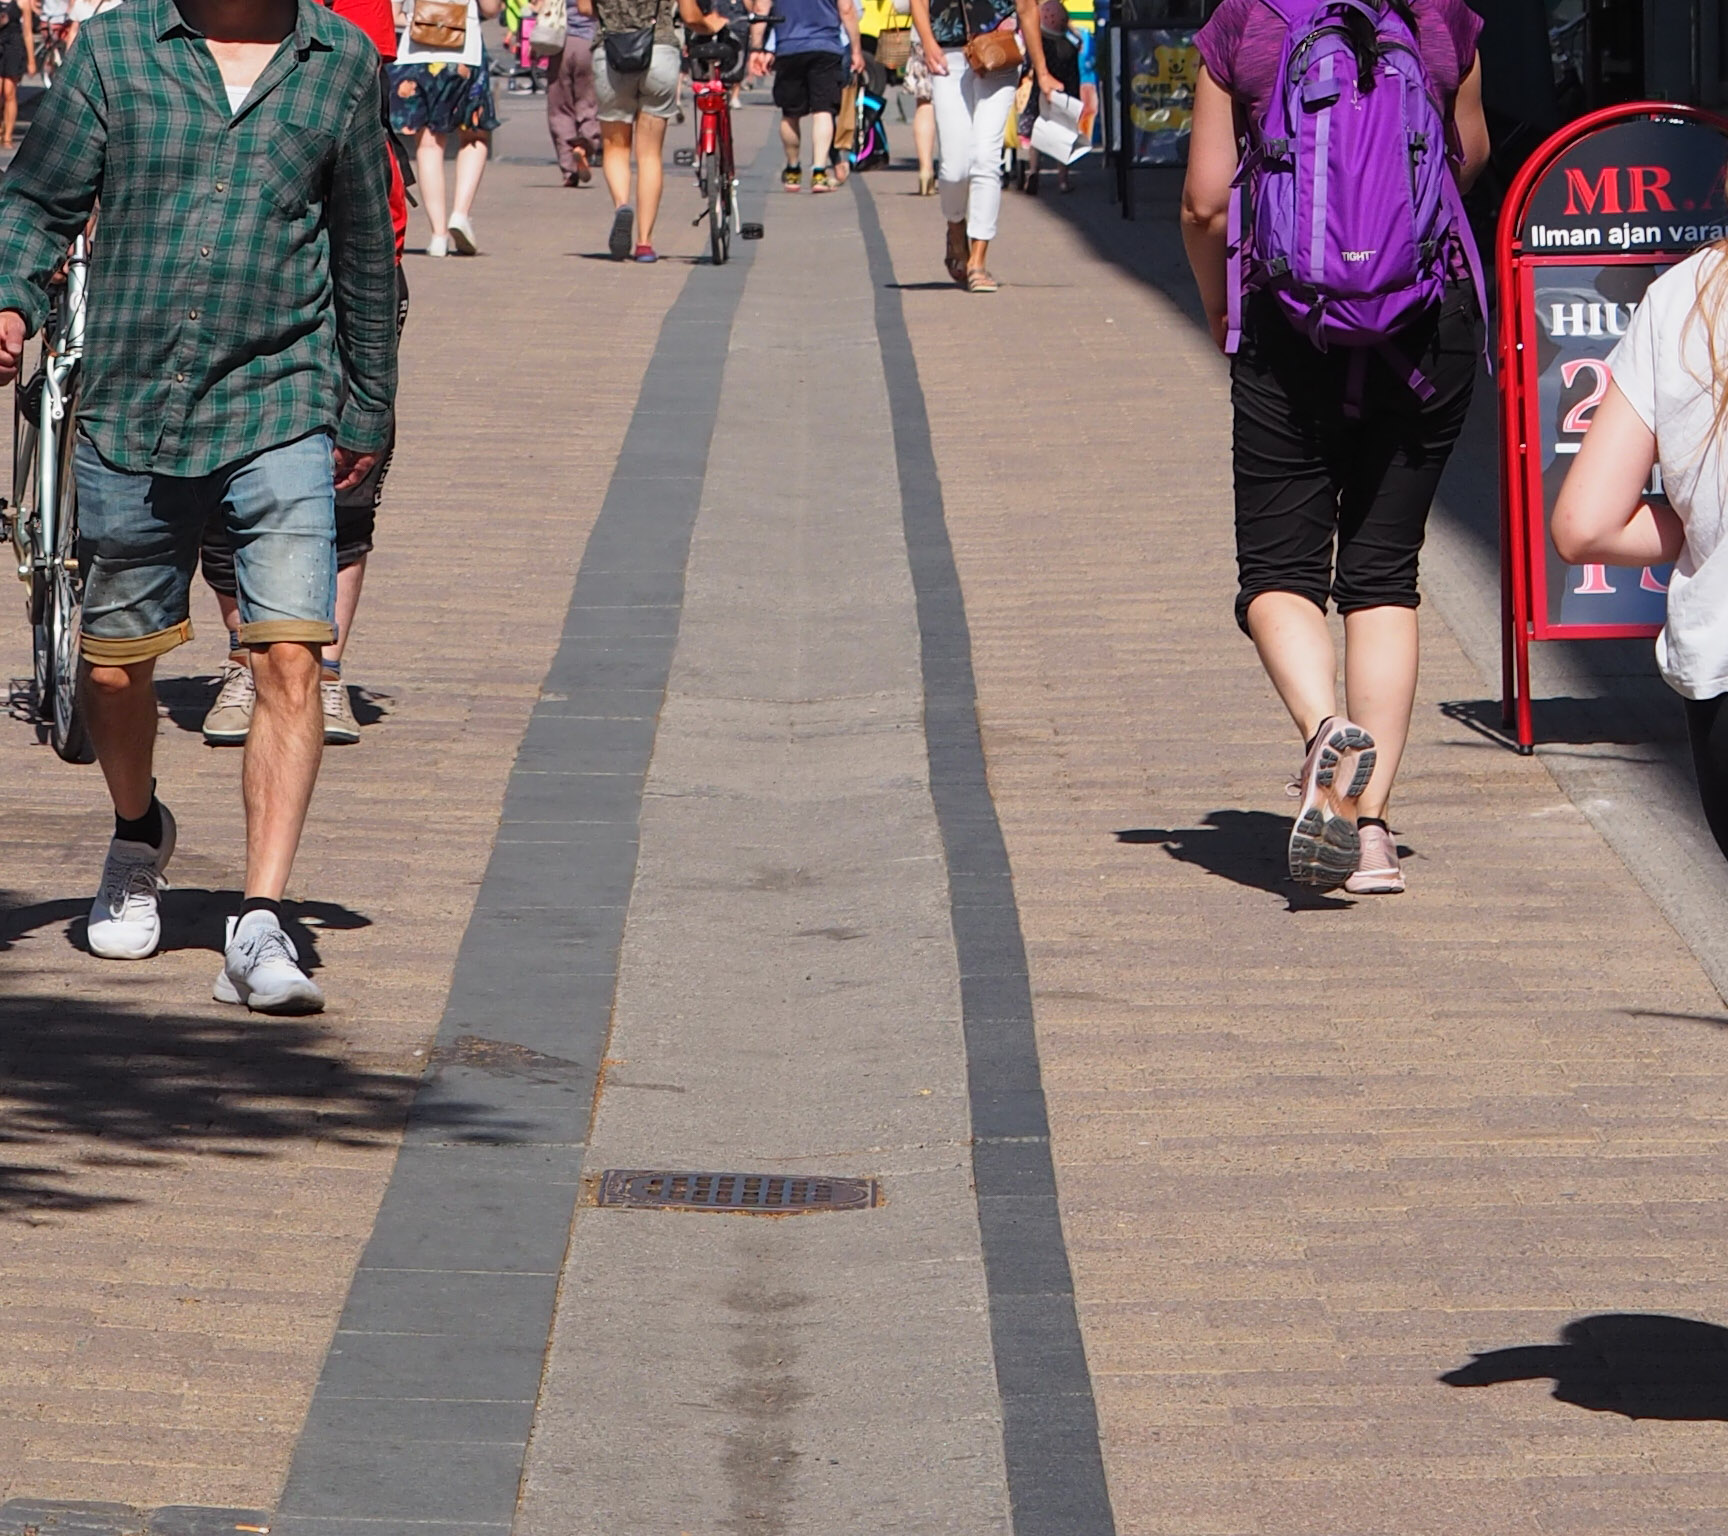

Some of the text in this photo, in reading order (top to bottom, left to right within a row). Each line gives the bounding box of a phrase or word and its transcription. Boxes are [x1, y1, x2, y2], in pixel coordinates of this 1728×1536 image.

[1531, 222, 1728, 250] Ilman ajan vara
[1550, 302, 1637, 337] HIU
